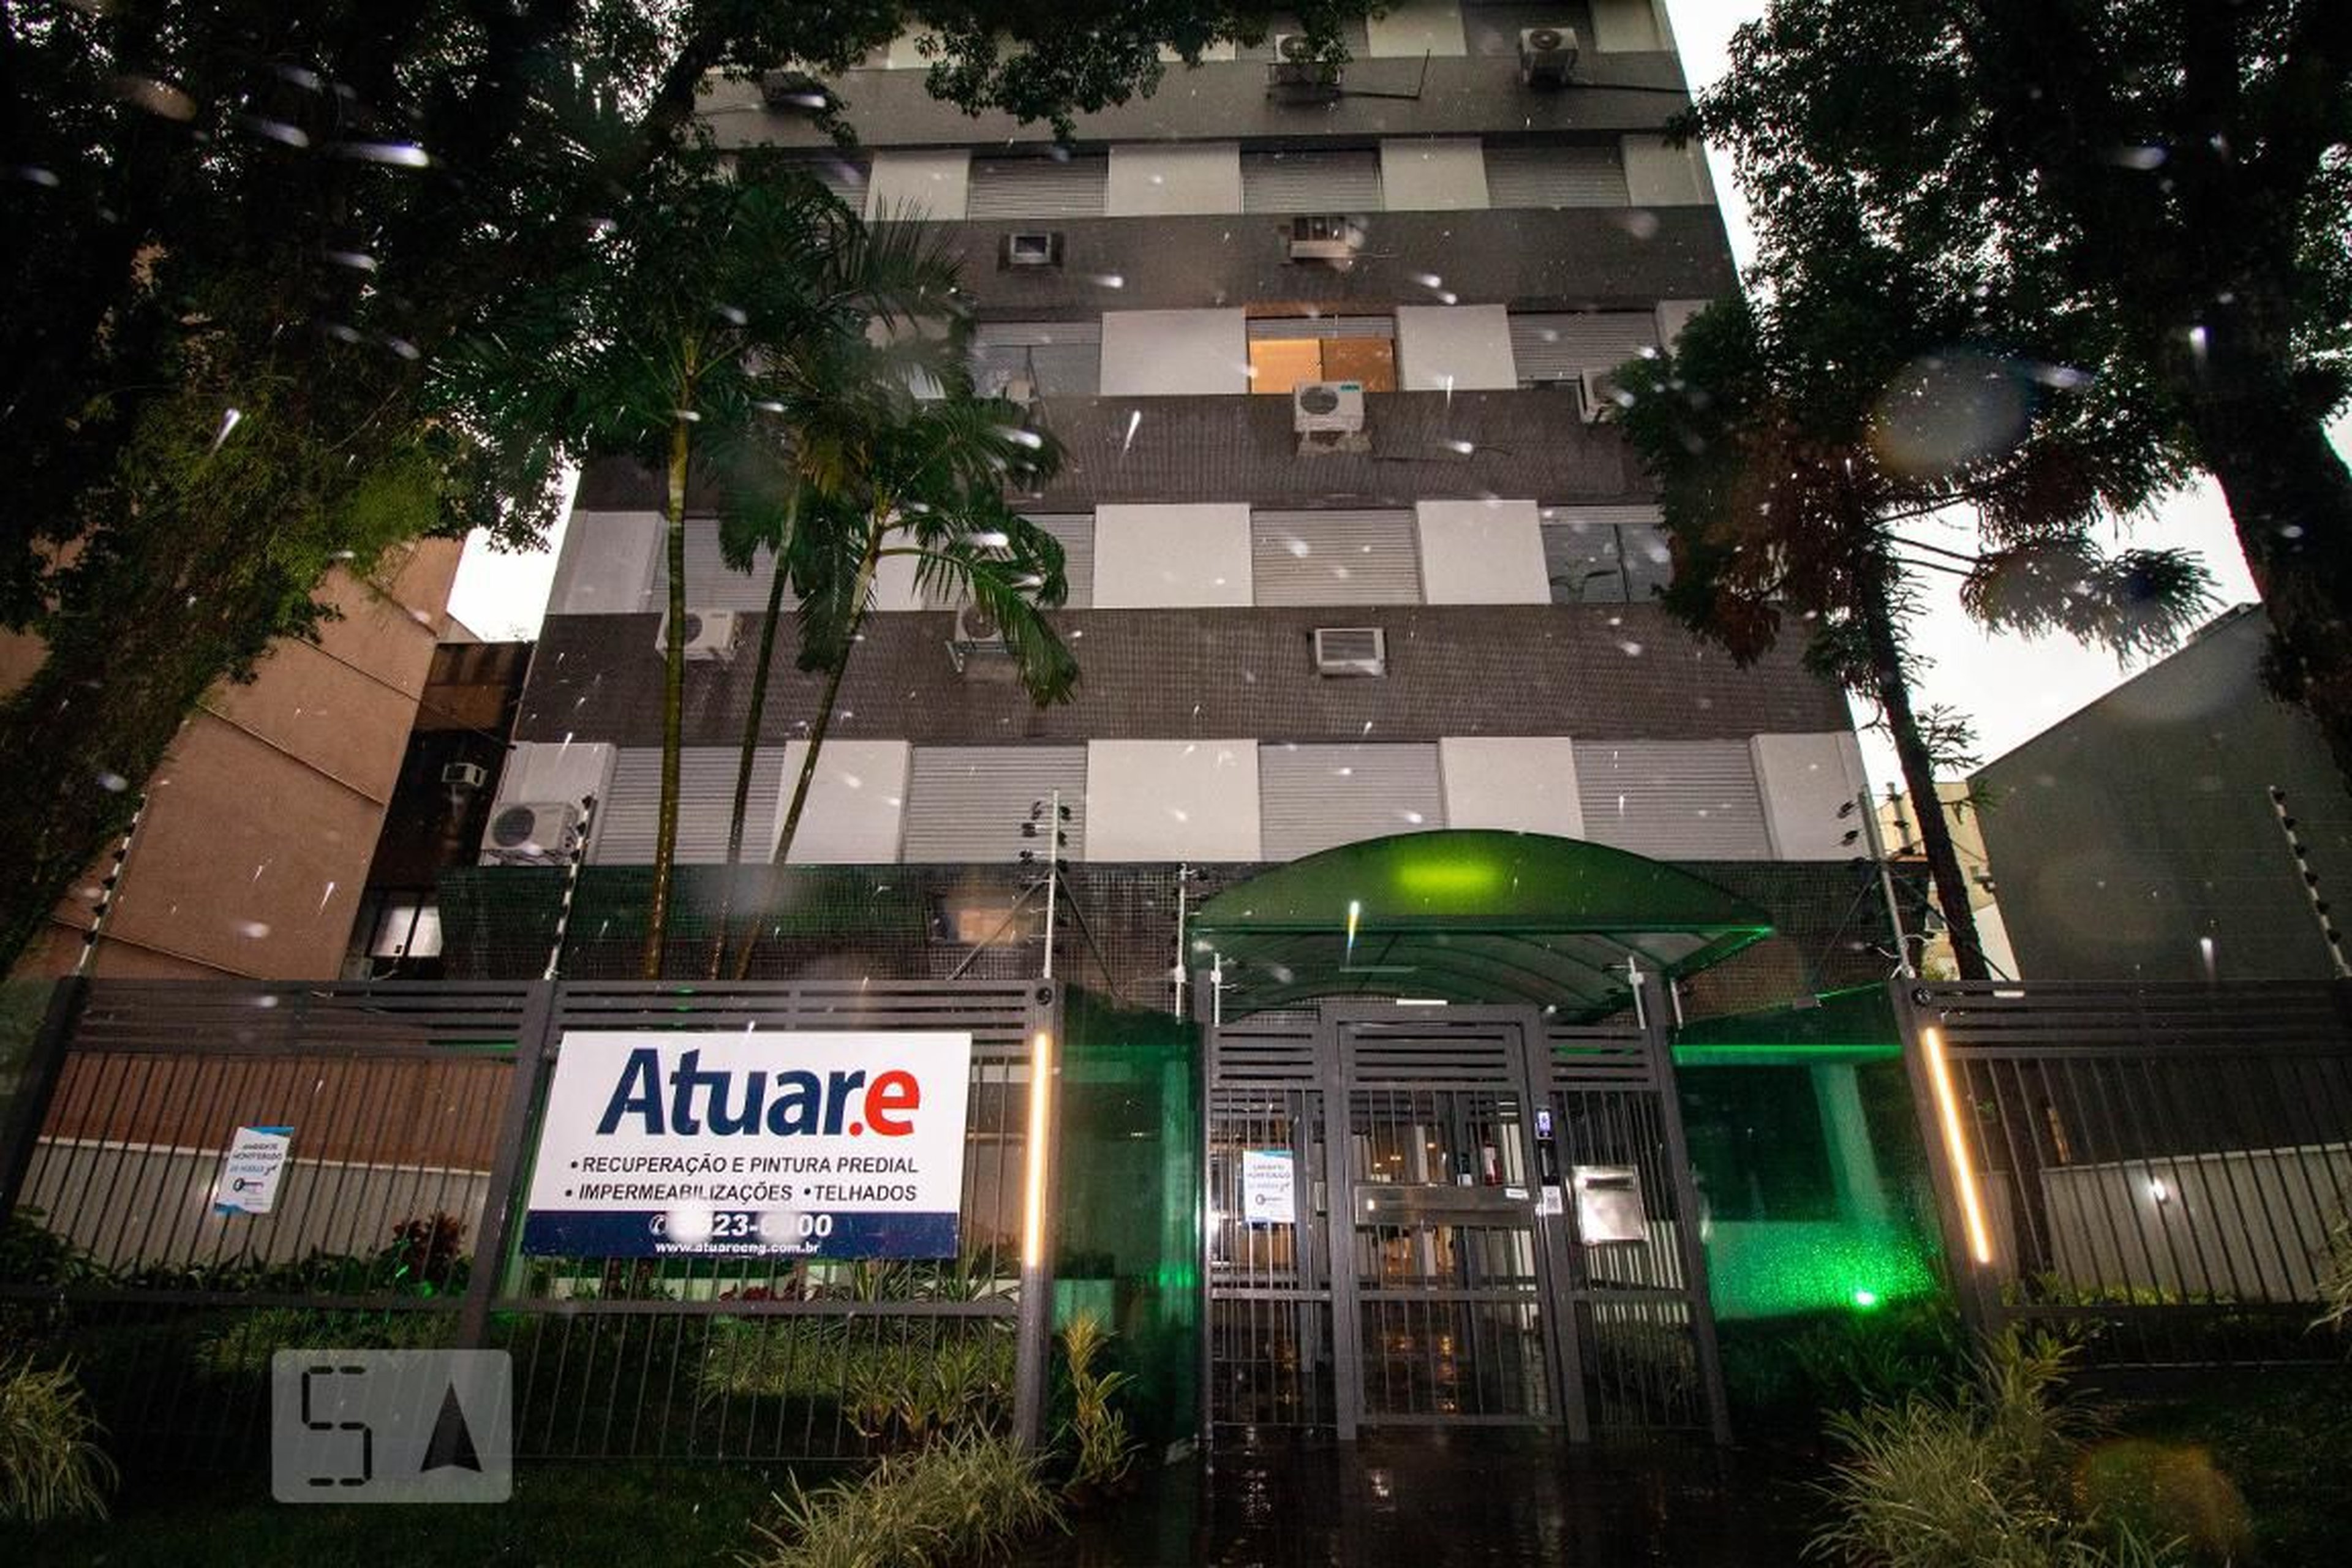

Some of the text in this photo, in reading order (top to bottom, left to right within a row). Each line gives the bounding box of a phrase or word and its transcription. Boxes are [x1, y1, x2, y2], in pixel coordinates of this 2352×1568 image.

[582, 1153, 919, 1176] RECUPERAÇÃO E PINTURA PREDIAL
[579, 1181, 917, 1205] IMPERMEABILIZAÇÕES TELHADOS
